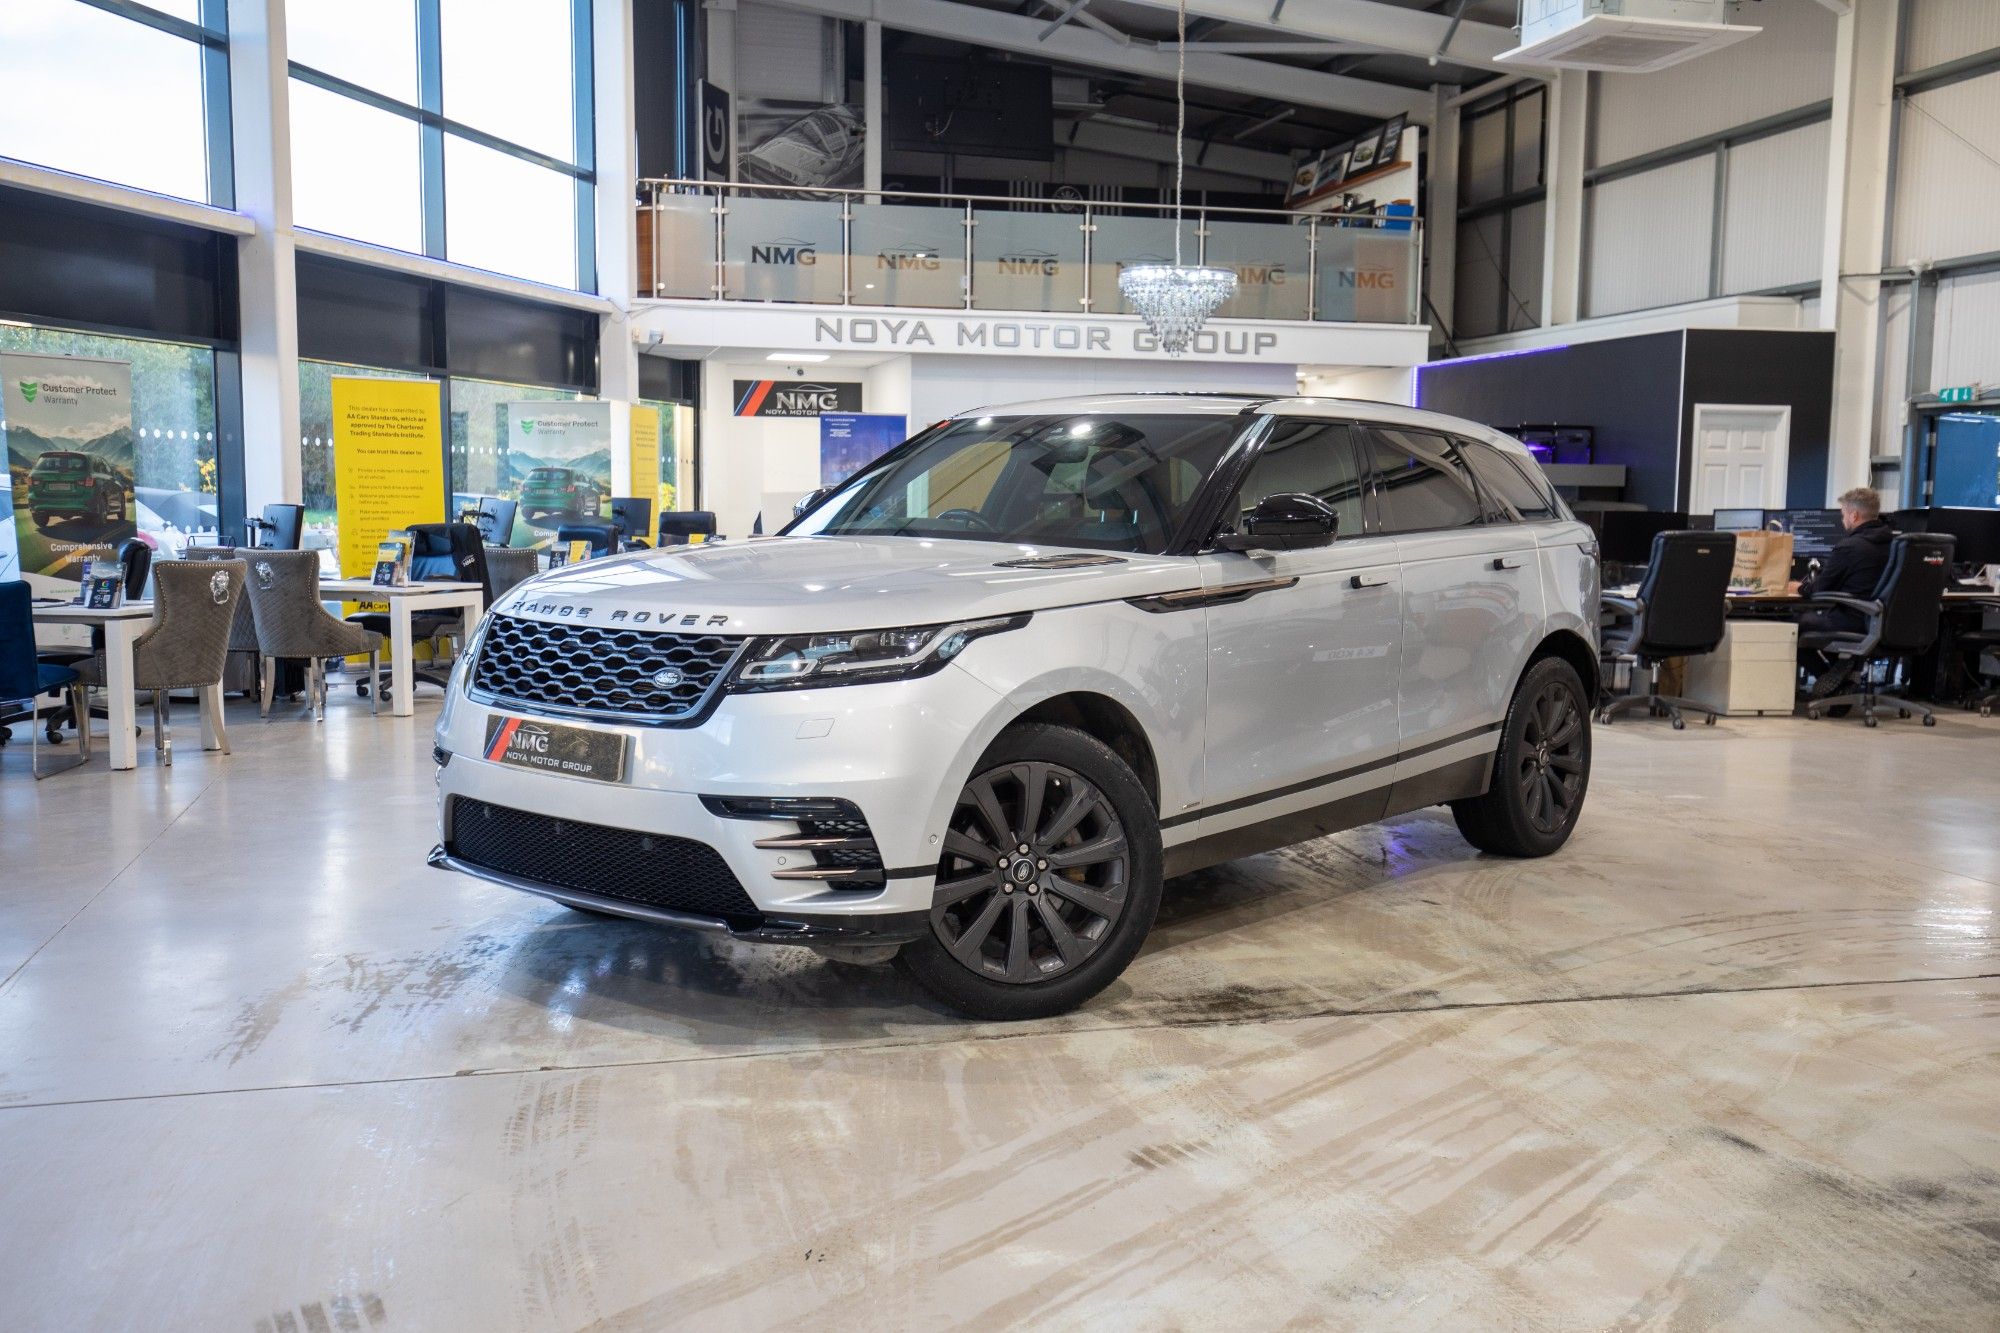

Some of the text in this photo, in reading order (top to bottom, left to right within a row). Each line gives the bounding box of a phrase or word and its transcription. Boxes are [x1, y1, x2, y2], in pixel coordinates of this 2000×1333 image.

[751, 245, 816, 266] NMG
[877, 253, 940, 270] NMG
[998, 256, 1059, 276] NMG
[1338, 270, 1395, 289] NMG
[815, 317, 1278, 355] NOYA MOTOR GOUP
[42, 383, 117, 396] Customer Protect
[43, 396, 78, 406] Warranty
[776, 392, 838, 410] NMG
[371, 414, 399, 422] Standards,
[765, 408, 787, 416] NOYA
[572, 420, 599, 428] Protect
[50, 542, 113, 552] Comprehensive
[65, 554, 101, 563] Warranty
[360, 601, 373, 609] AA
[511, 600, 729, 627] RANGE ROVER
[507, 731, 549, 752] NMG
[506, 751, 592, 773] NOYA MOTOR GROUP
